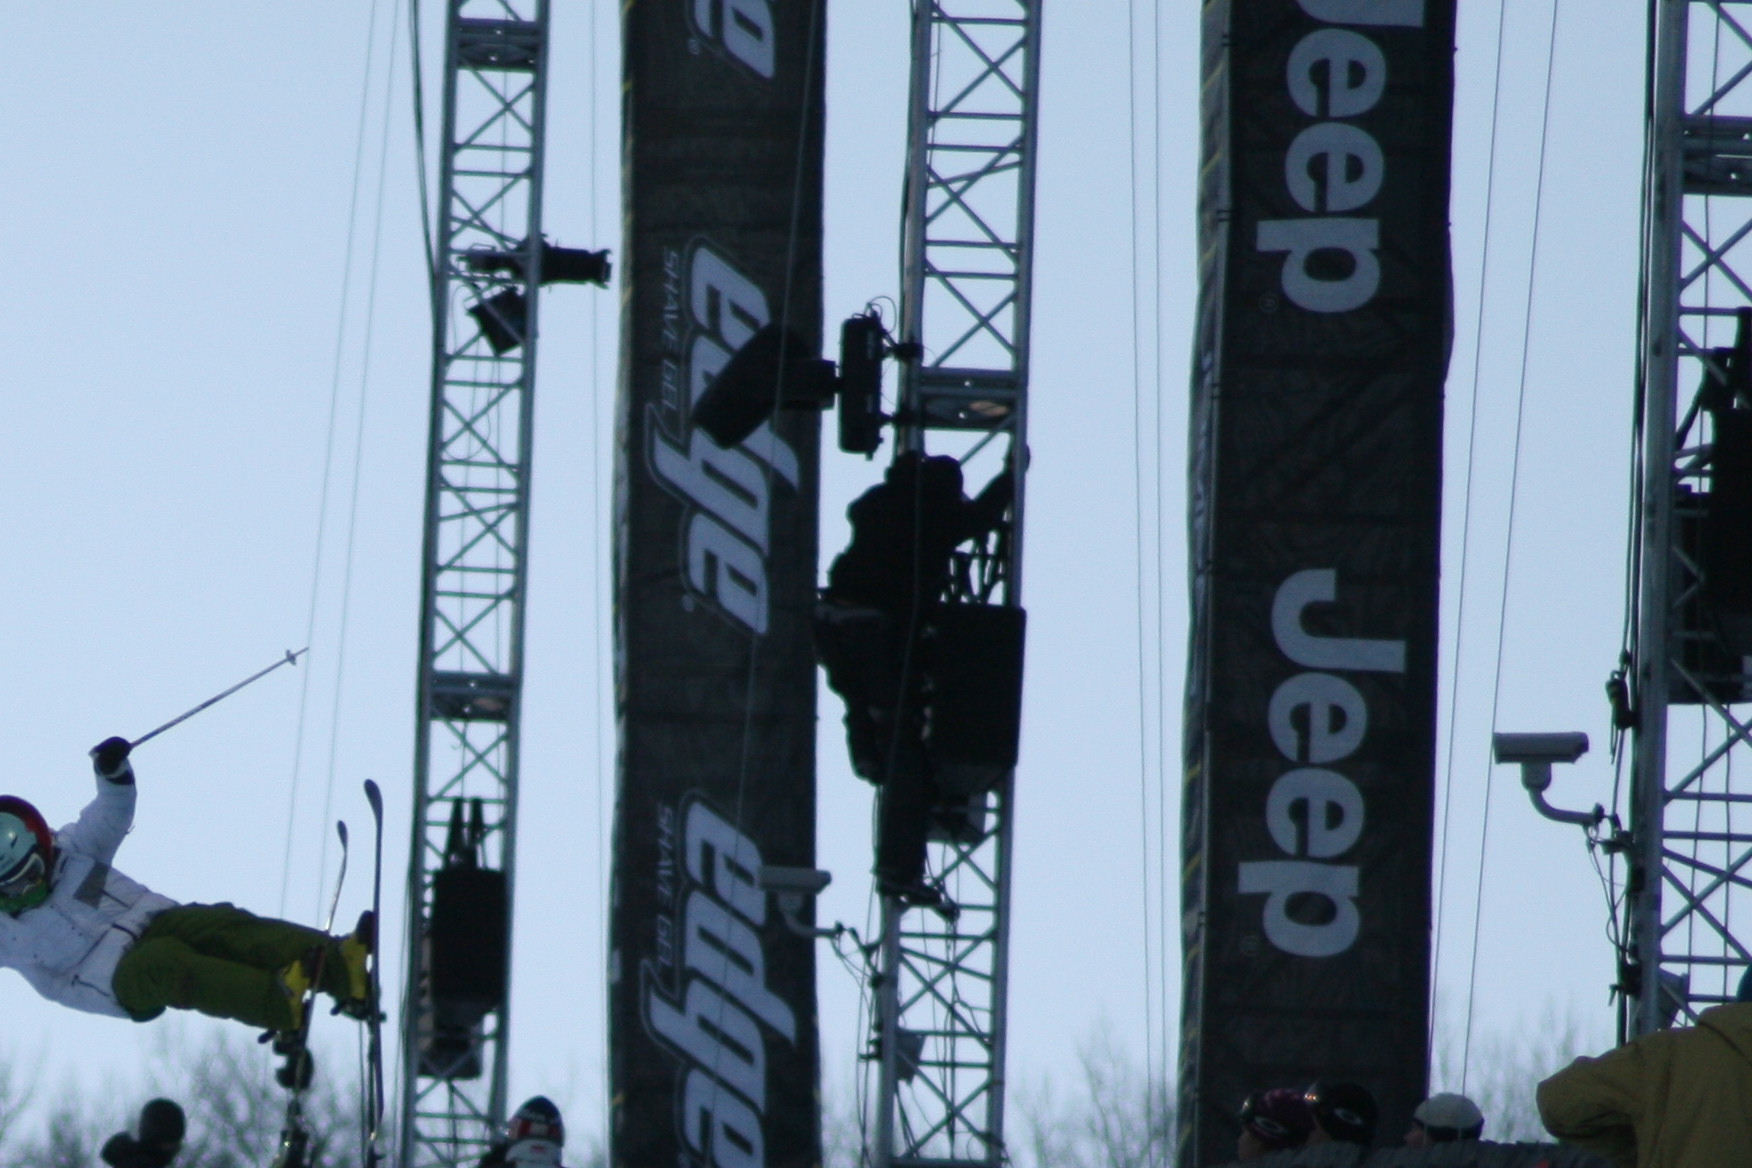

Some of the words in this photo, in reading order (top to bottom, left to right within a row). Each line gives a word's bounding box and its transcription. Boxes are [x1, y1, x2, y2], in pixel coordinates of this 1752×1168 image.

[1256, 0, 1425, 313] eep
[661, 246, 679, 351] SHAVE
[661, 356, 679, 411] GEL
[1237, 568, 1406, 958] Jeep
[656, 803, 674, 908] SHAVE
[655, 914, 673, 971] GEL
